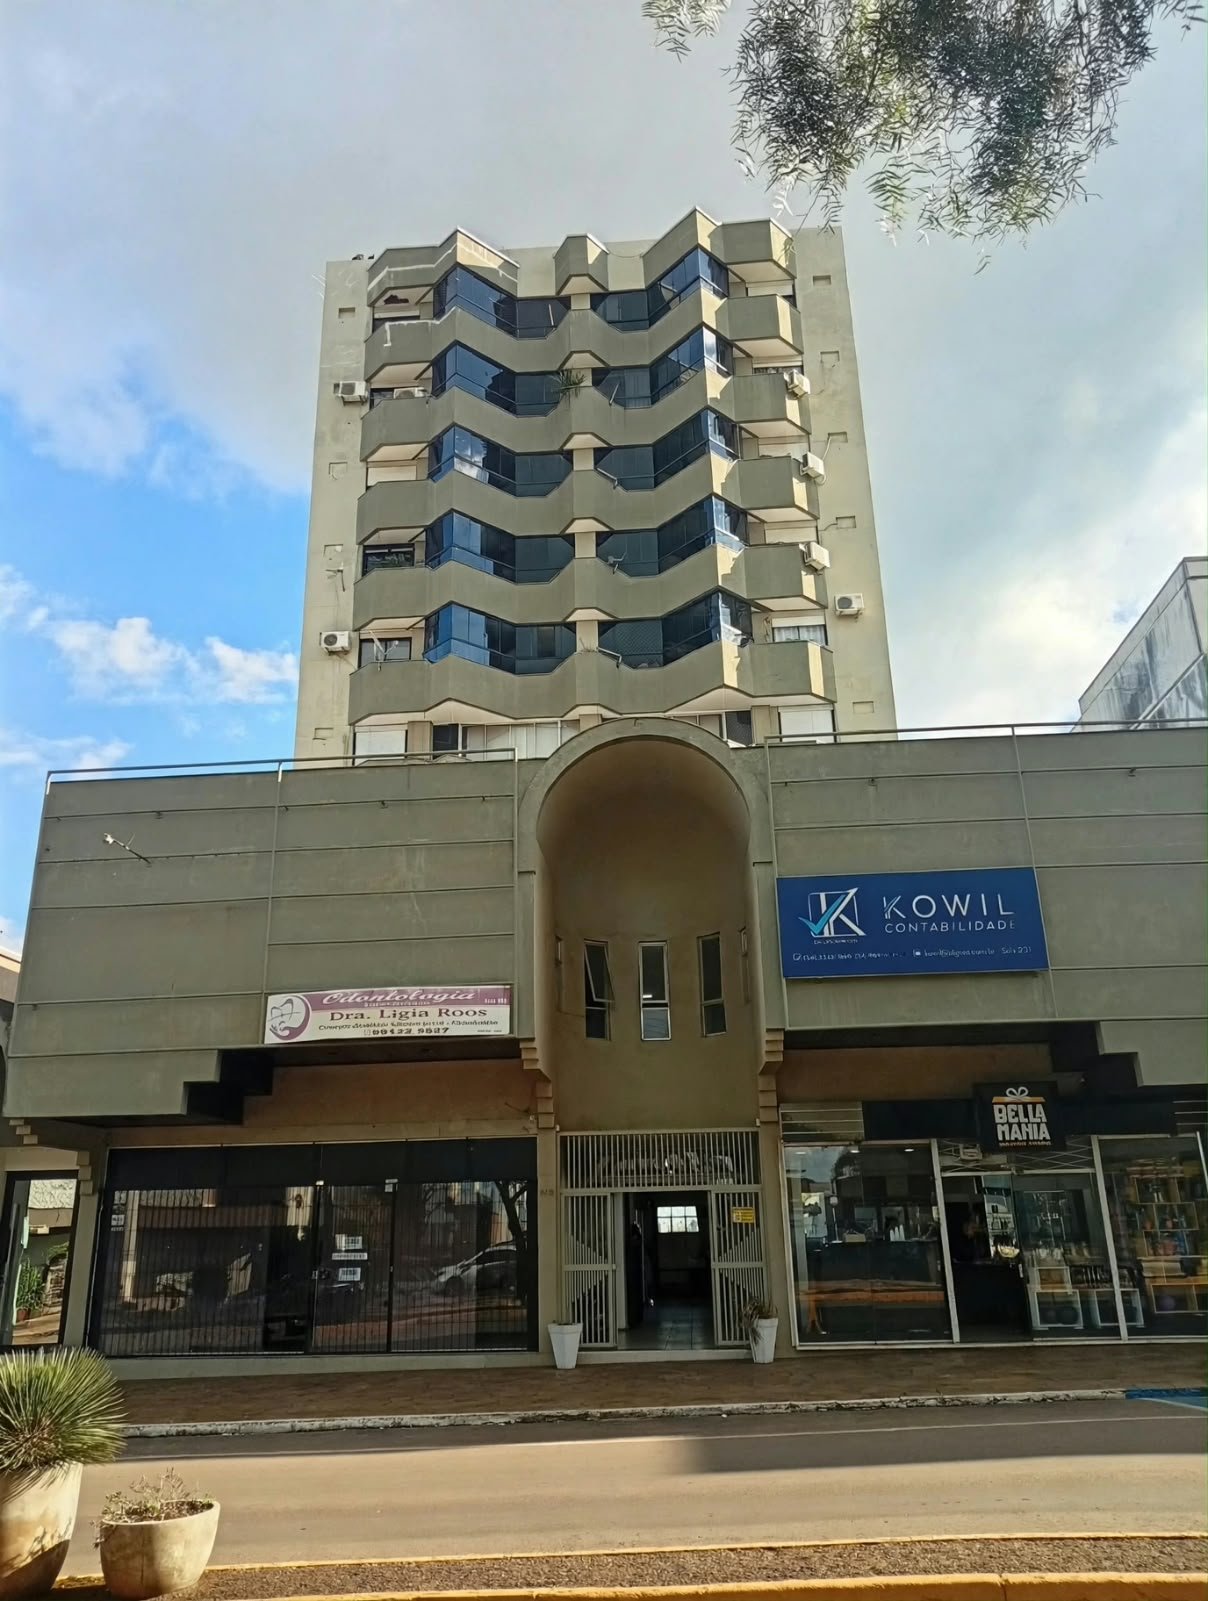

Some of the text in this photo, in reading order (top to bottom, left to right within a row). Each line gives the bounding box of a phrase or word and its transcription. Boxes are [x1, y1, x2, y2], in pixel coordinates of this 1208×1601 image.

[882, 893, 1015, 920] KOWIL
[884, 919, 1016, 934] CONTABILIDADE
[322, 990, 476, 1004] Odontologia
[330, 1007, 488, 1021] Dra. Ligia Roos
[993, 1103, 1048, 1124] BELLA
[996, 1123, 1051, 1141] MANIA
